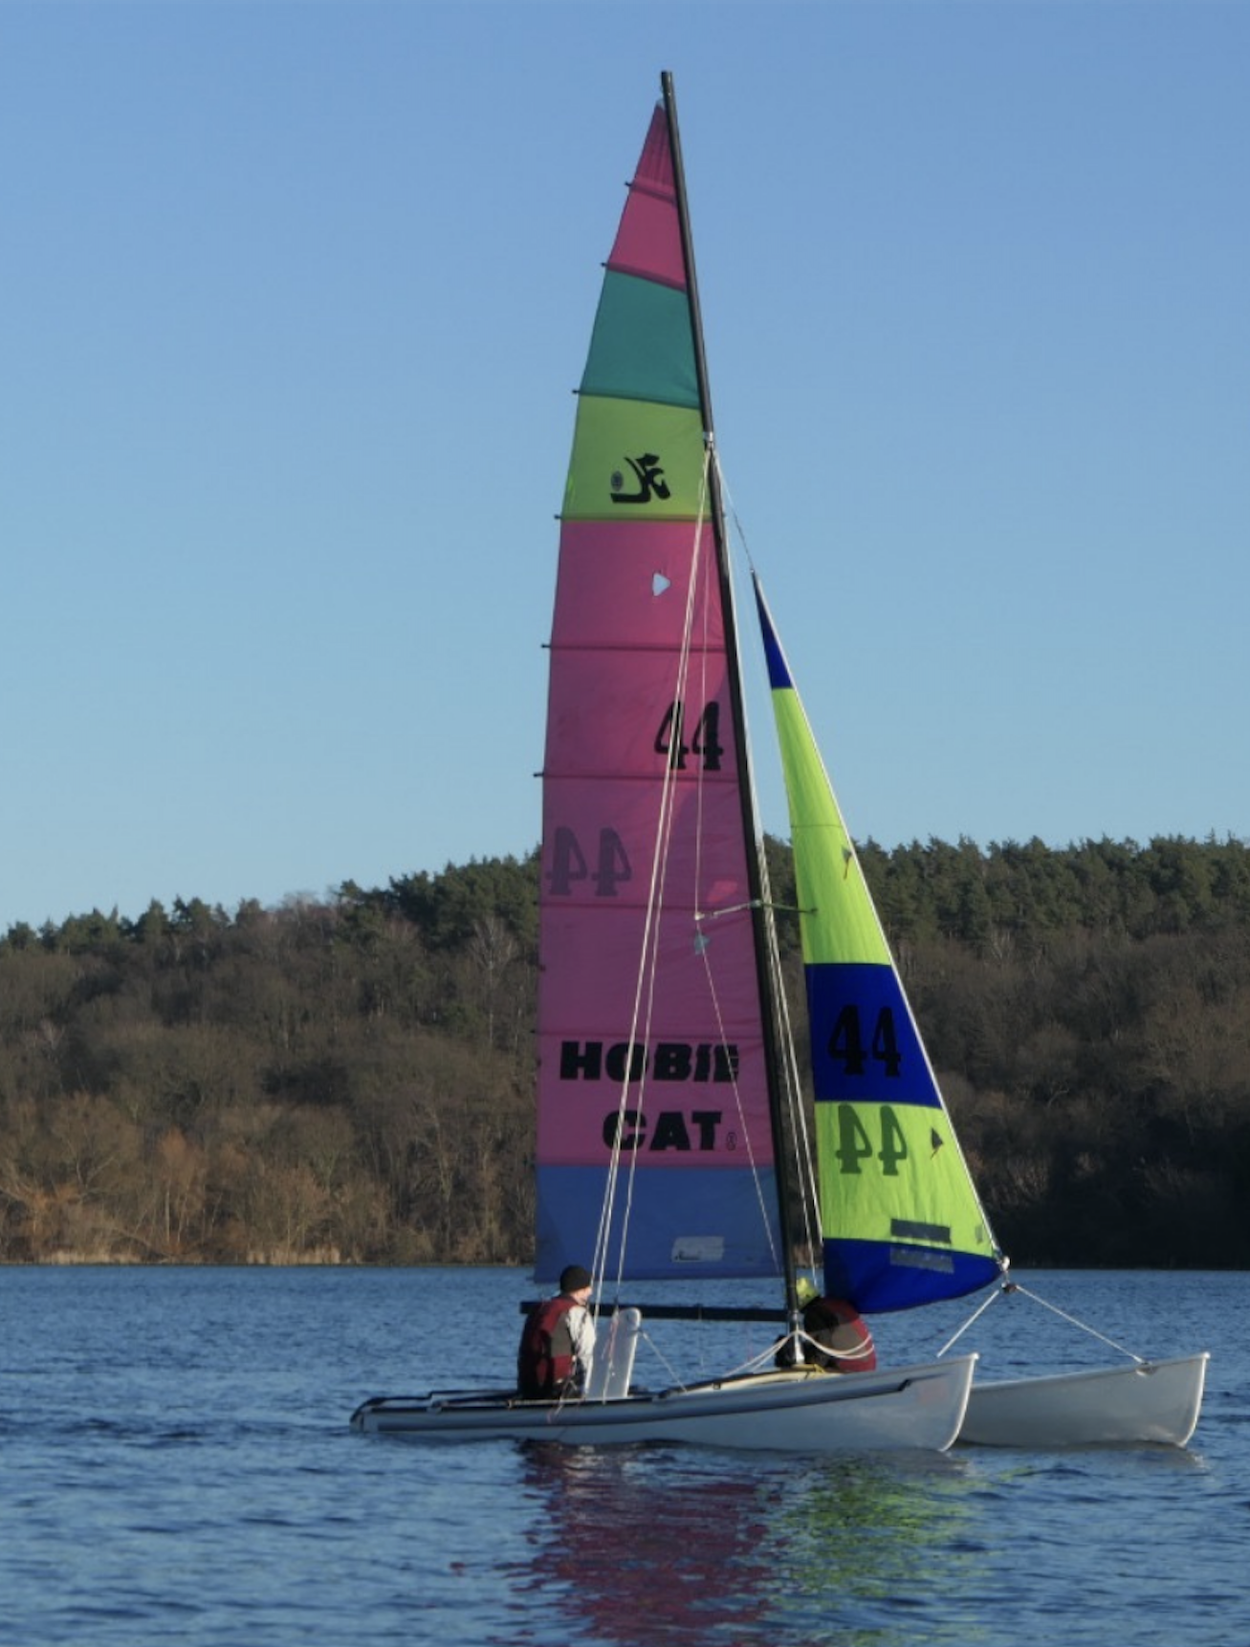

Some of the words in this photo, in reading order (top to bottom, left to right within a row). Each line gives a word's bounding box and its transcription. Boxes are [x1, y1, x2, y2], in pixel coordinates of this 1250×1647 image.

[653, 699, 726, 771] 44
[559, 1040, 740, 1083] HOBIE
[827, 1004, 903, 1078] 44
